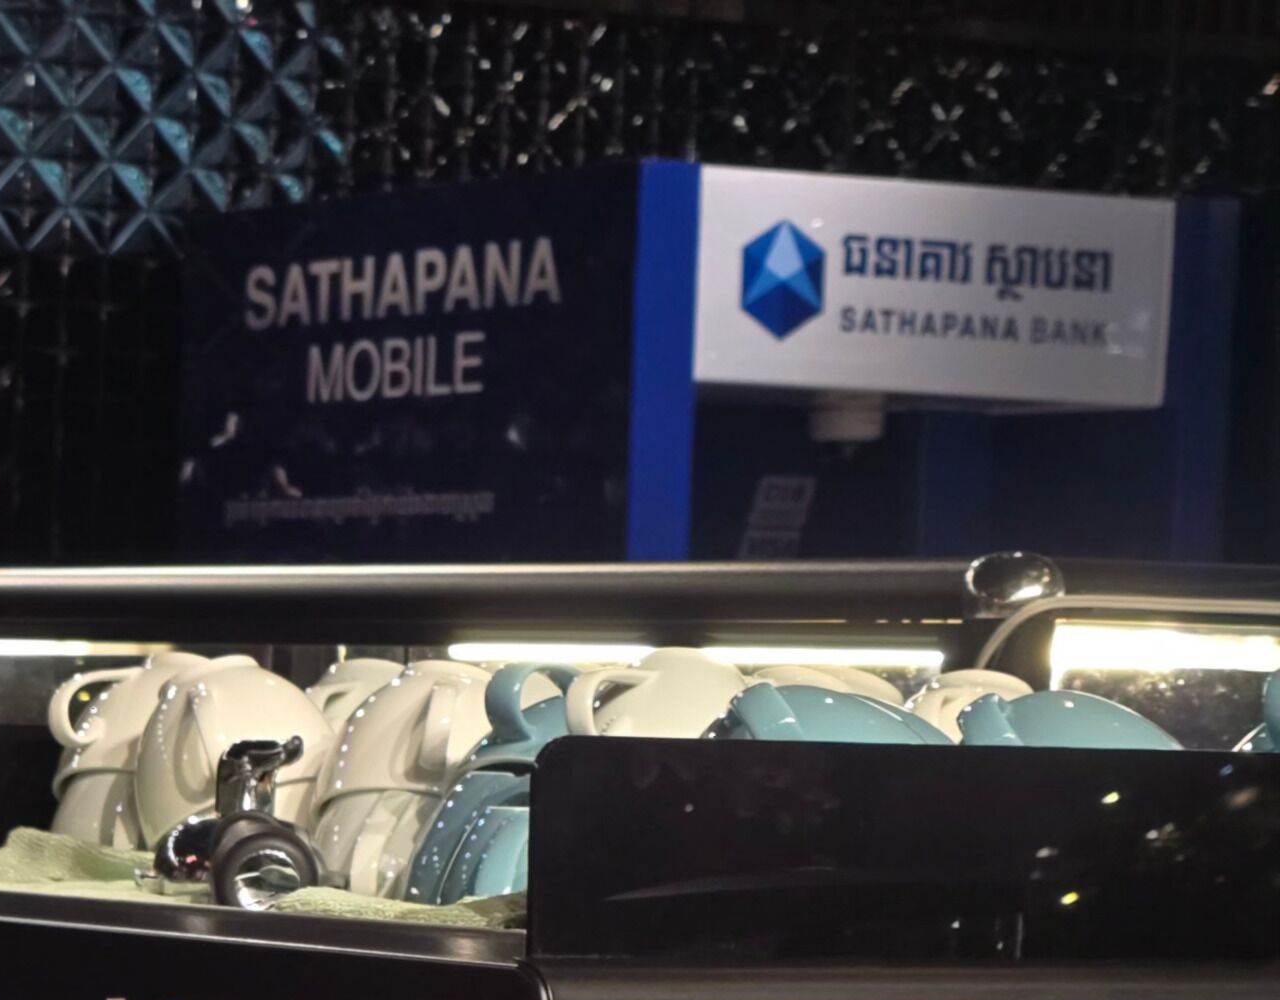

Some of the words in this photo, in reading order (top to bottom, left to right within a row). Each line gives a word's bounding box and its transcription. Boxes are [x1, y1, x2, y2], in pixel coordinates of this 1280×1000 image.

[245, 236, 562, 330] SATHAPANA
[843, 234, 972, 284] ធនាគារ
[840, 306, 1020, 343] SATHAPANA
[1029, 318, 1109, 347] BANK
[307, 331, 486, 403] MOBILE
